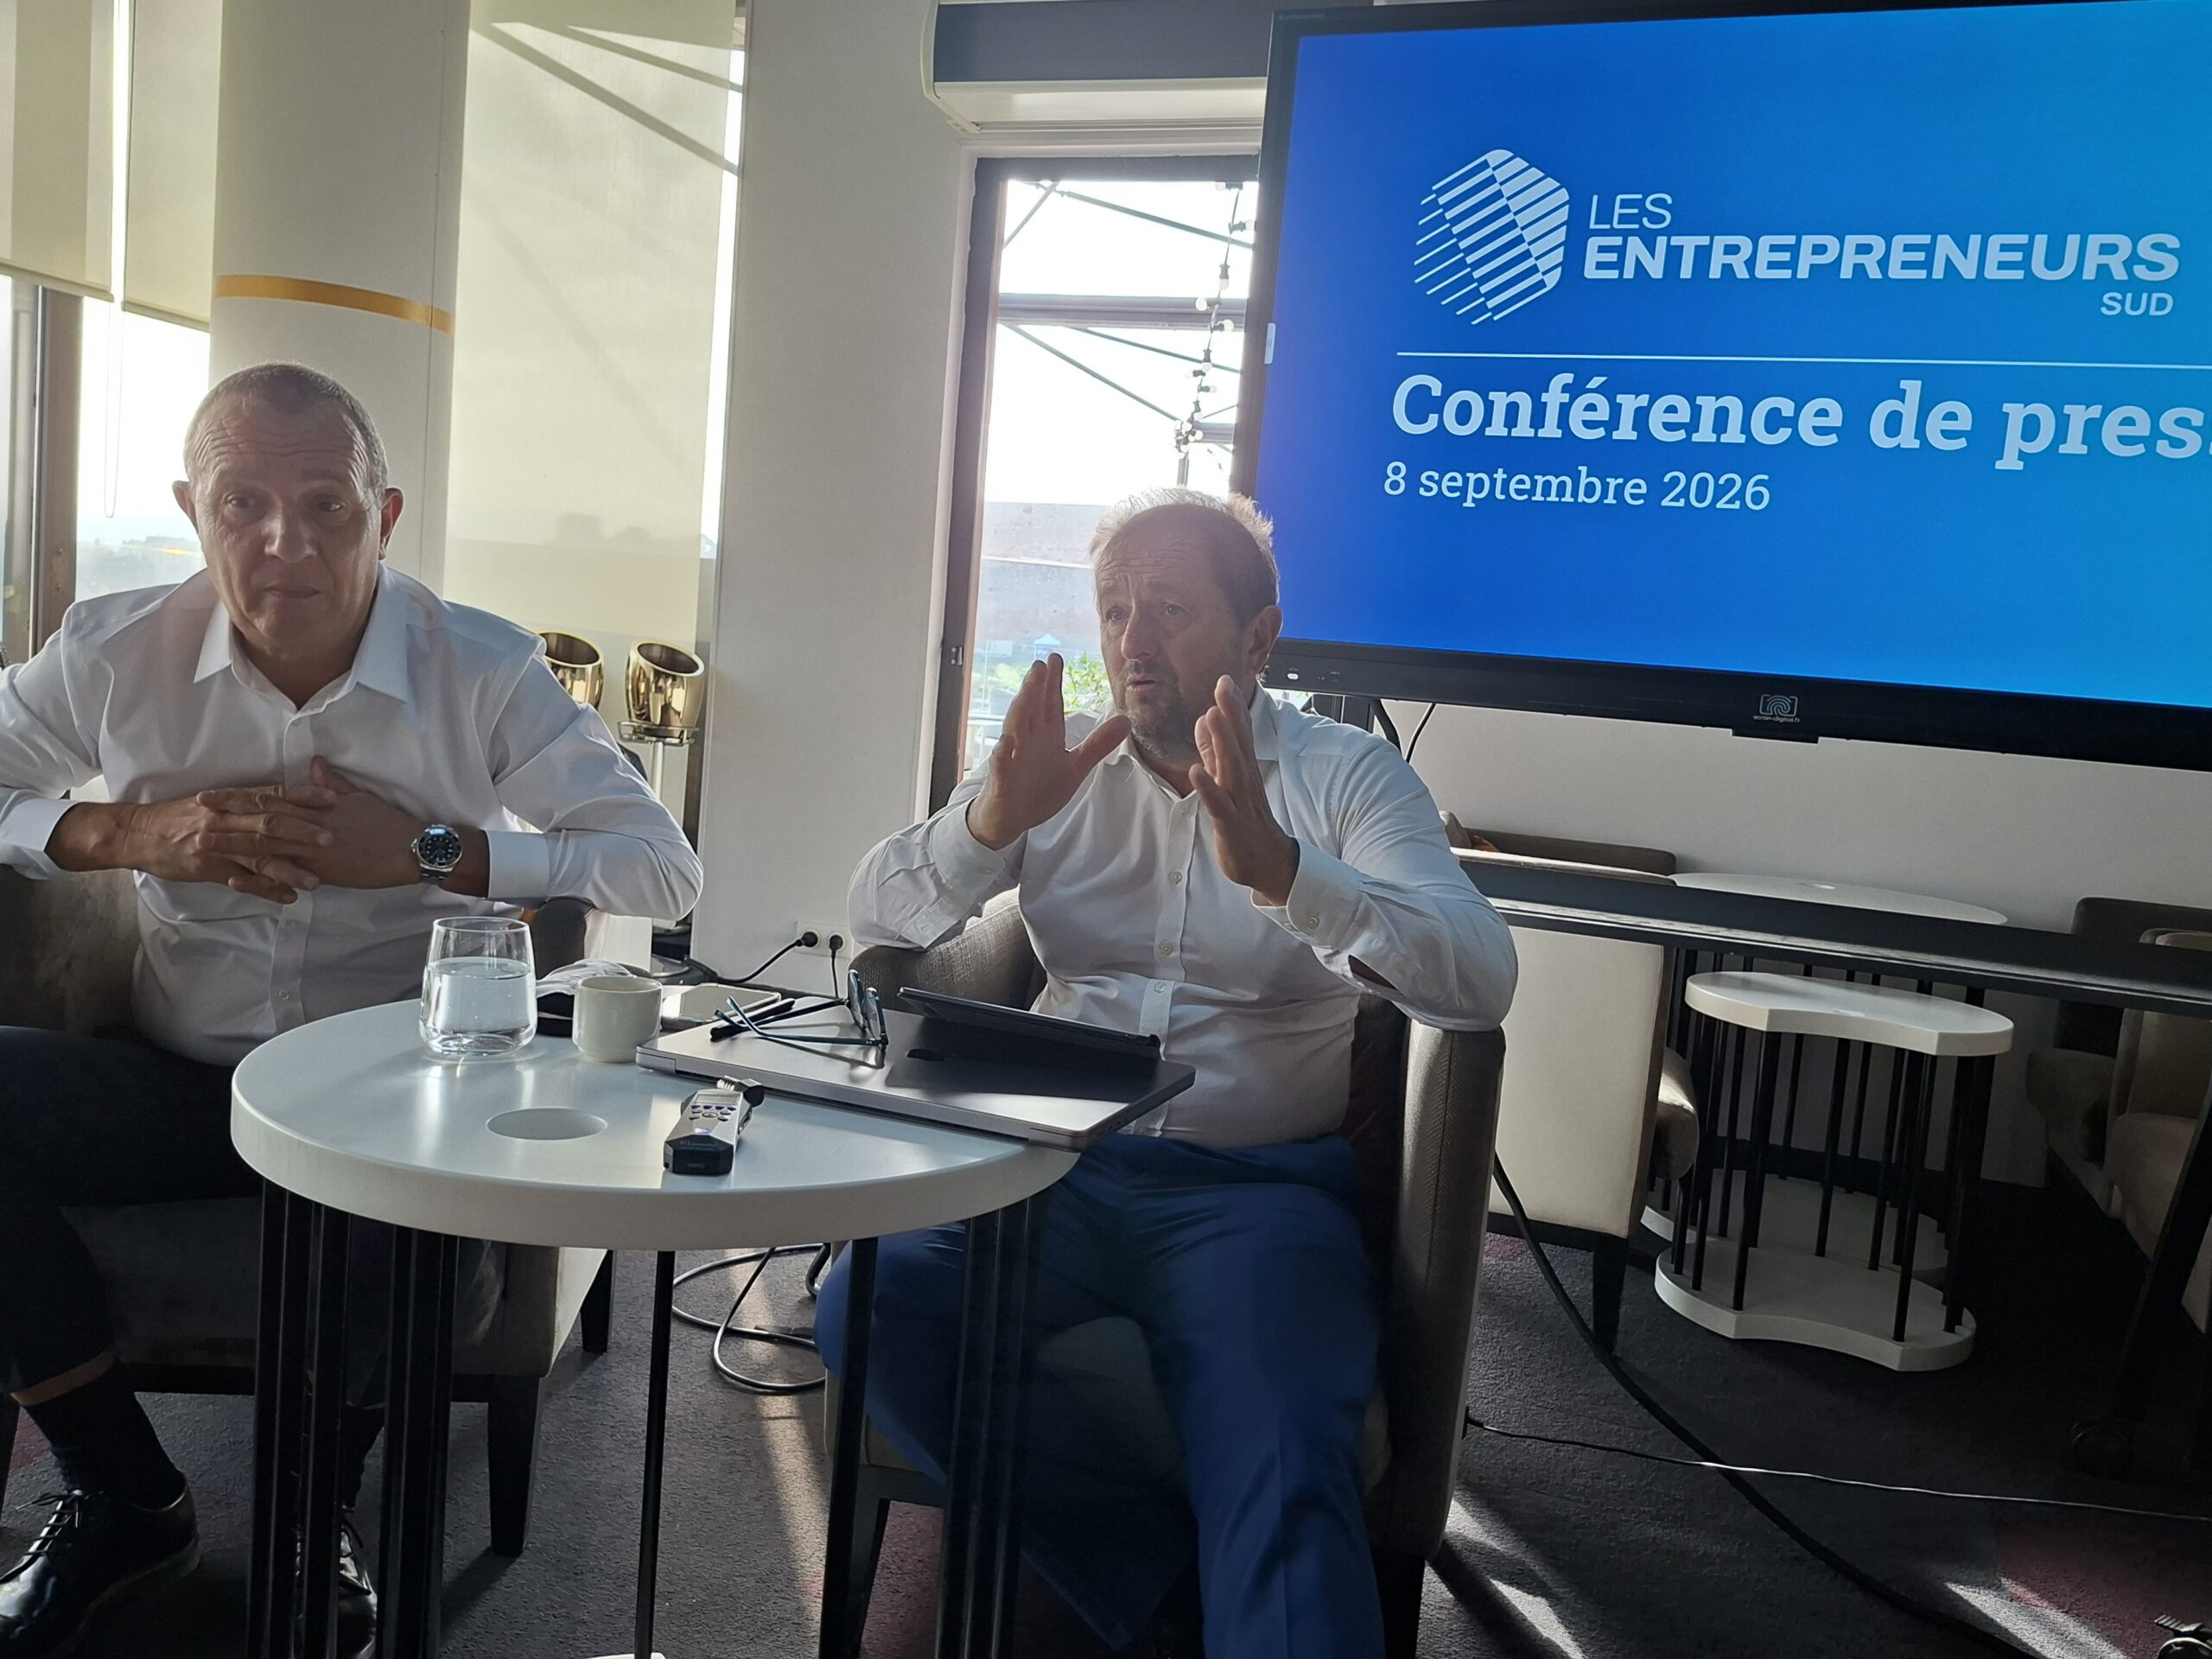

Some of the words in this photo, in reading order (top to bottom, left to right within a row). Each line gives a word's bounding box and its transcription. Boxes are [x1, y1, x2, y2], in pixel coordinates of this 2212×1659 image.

[1589, 193, 1673, 229] LES
[1583, 234, 2180, 281] ENTREPRENEURS
[2101, 292, 2173, 316] SUD
[1392, 373, 1843, 447] Conférence
[1869, 379, 1973, 451] de
[1994, 403, 2212, 471] pres
[1383, 461, 1407, 495] 8
[1419, 466, 1647, 507] septembre
[1661, 471, 1770, 511] 2026
